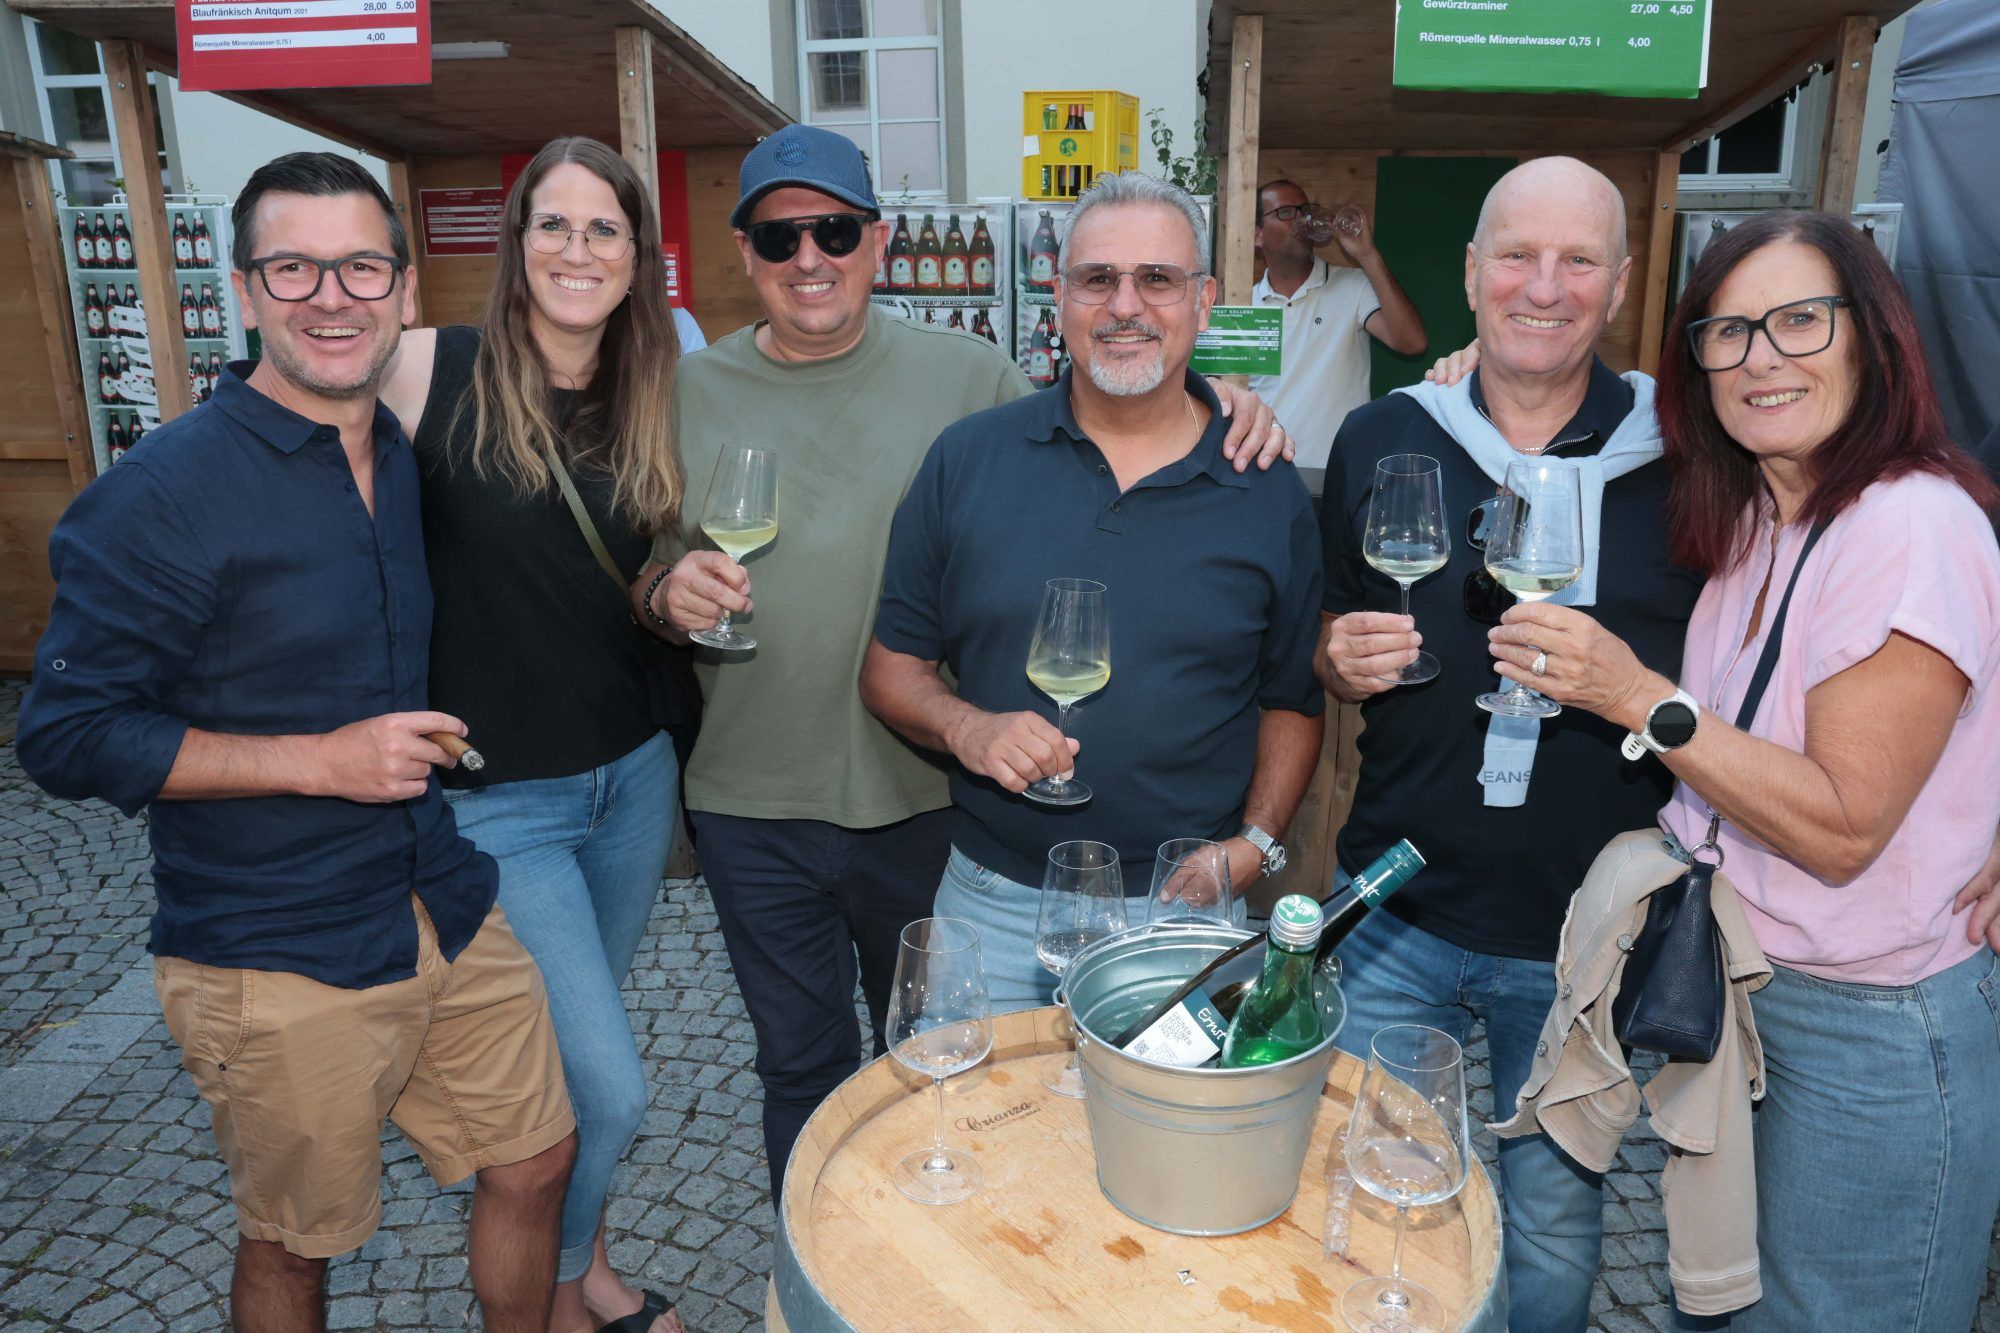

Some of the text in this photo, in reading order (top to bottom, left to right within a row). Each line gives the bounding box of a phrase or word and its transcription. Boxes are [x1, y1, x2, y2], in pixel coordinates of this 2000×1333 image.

[192, 7, 252, 17] Blaufränkisch
[254, 7, 292, 18] Anitqum
[363, 2, 387, 12] 28,00
[396, 1, 415, 10] 5,00
[1423, 0, 1693, 15] Gewürztraminer 27,00 4,50
[231, 39, 275, 47] Mineralwasser
[366, 33, 386, 42] 4,00
[1419, 32, 1486, 44] Römerquelle
[1489, 34, 1567, 46] Mineralwasser
[1568, 36, 1591, 48] 0,75
[1627, 37, 1651, 48] 4,00
[1484, 770, 1532, 784] EANS
[1197, 1007, 1228, 1040] Ernst
